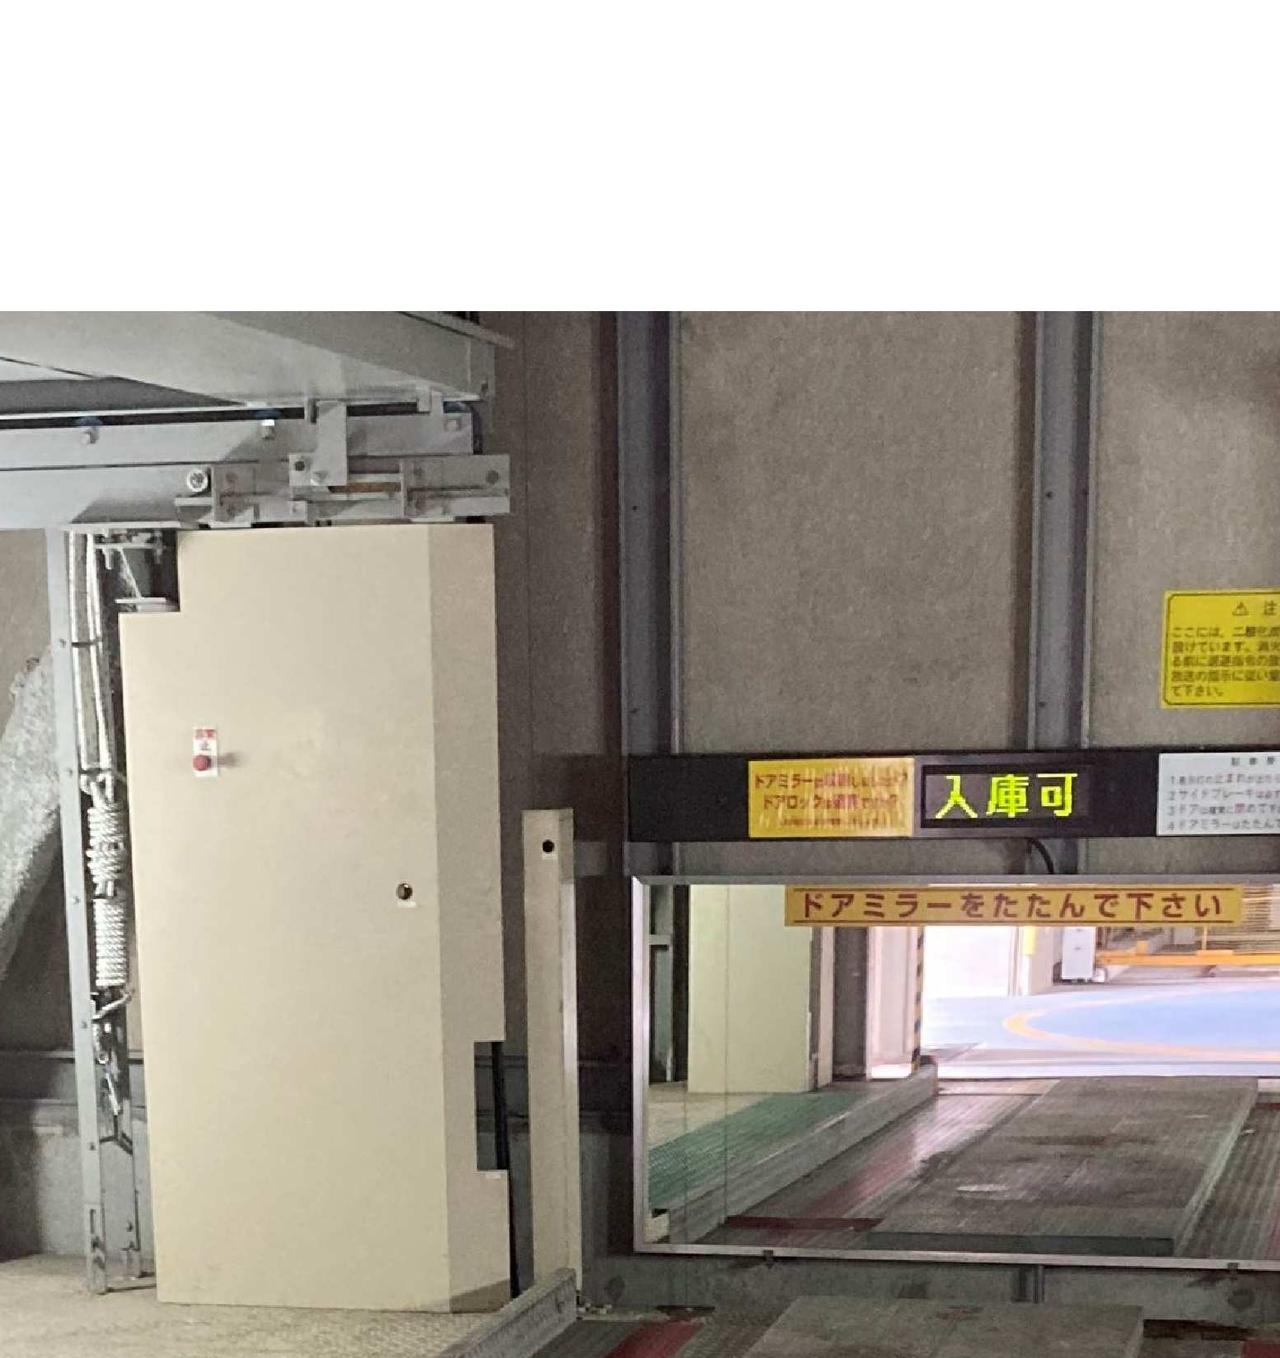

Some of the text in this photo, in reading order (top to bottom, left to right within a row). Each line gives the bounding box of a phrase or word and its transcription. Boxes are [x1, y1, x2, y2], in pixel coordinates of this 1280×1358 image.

[935, 772, 1079, 819] 入庫可
[802, 891, 1223, 921] ドアミラーをたたんで下さい
